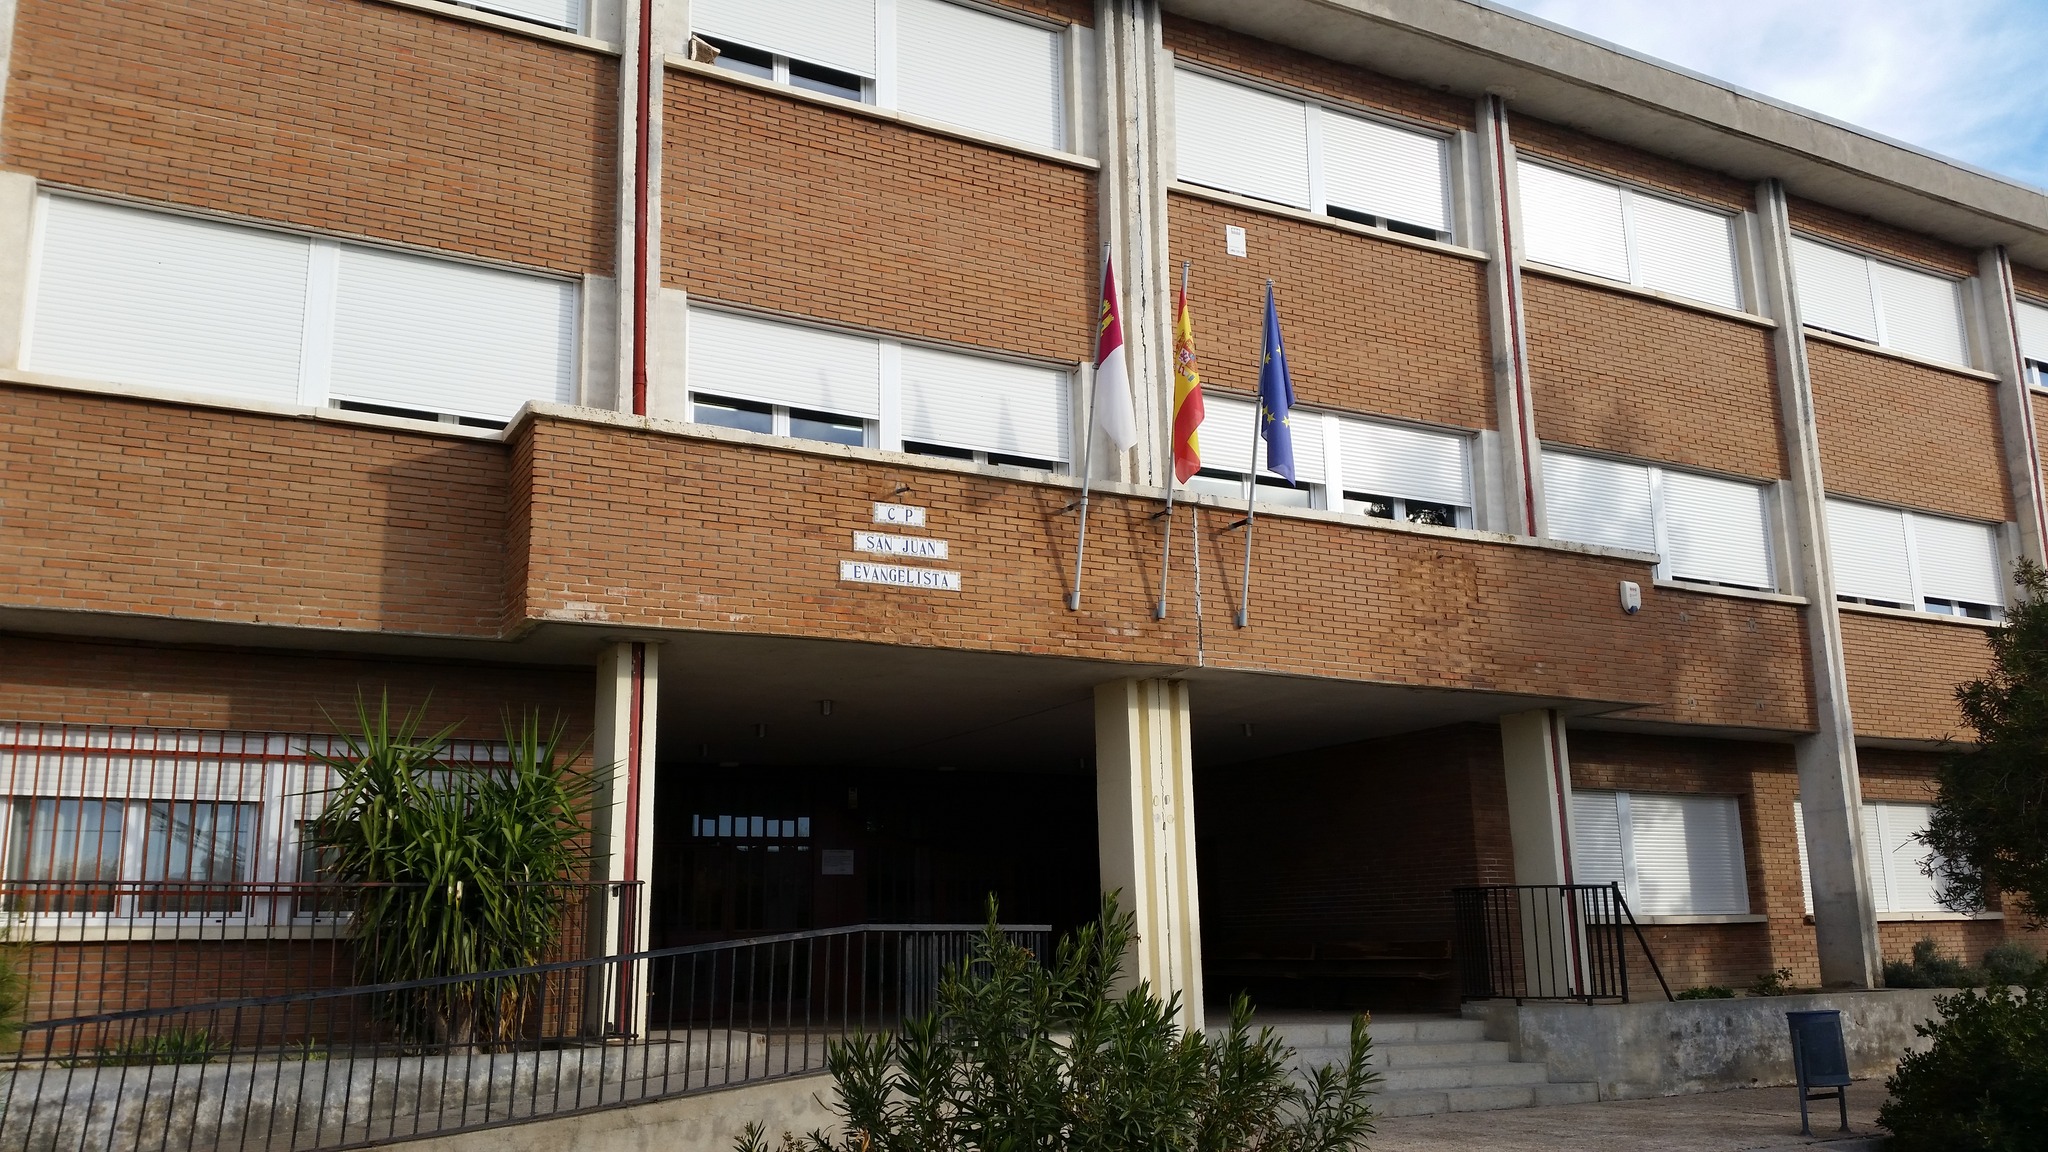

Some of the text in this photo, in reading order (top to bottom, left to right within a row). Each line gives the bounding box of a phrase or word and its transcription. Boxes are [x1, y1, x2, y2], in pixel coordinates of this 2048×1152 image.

[866, 535, 936, 555] SAN JUAN
[853, 565, 949, 587] EVANGELISTA
